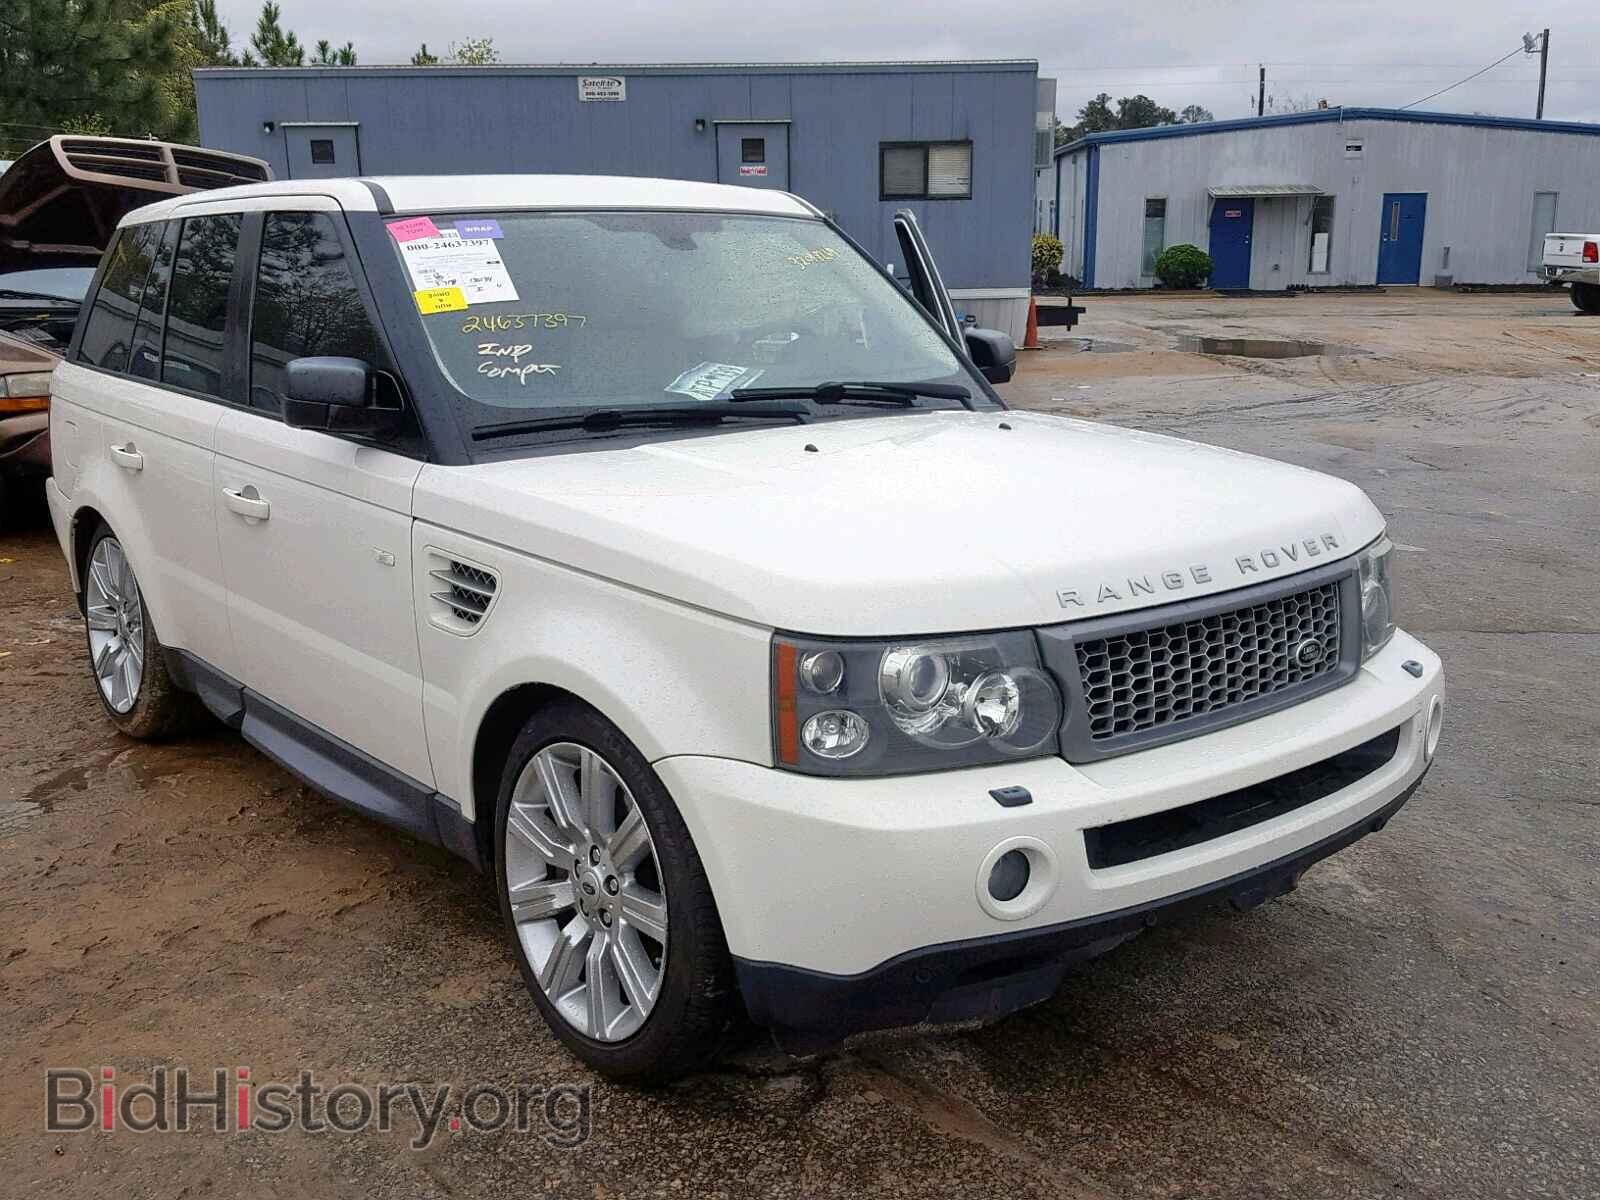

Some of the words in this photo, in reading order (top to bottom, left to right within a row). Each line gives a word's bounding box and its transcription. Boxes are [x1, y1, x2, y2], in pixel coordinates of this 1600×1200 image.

[407, 239, 490, 252] 000-24637397
[462, 313, 586, 333] 24637397
[1056, 565, 1212, 608] RANGE
[1235, 533, 1339, 575] ROVER
